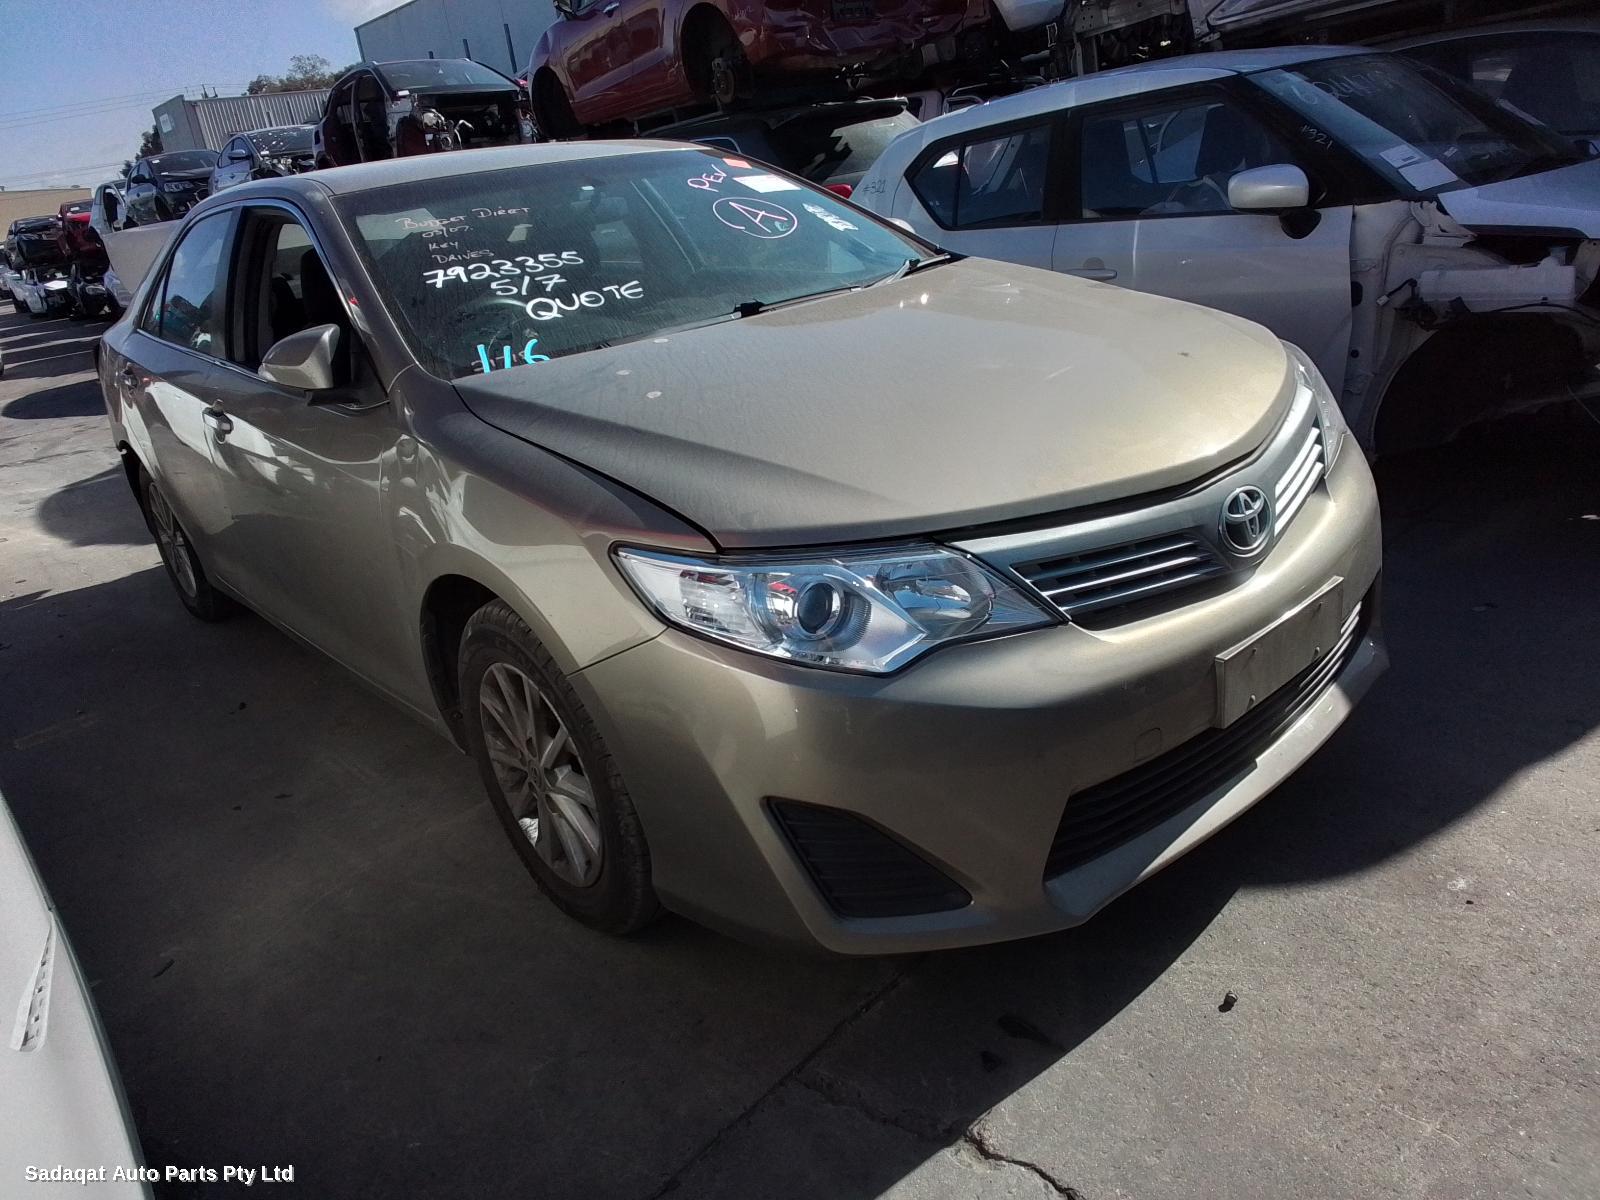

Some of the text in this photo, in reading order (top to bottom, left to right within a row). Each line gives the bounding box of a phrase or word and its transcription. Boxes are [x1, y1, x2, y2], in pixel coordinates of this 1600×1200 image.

[423, 251, 584, 288] 7923355
[490, 273, 567, 296] 5/7
[525, 281, 645, 321] QUOTE
